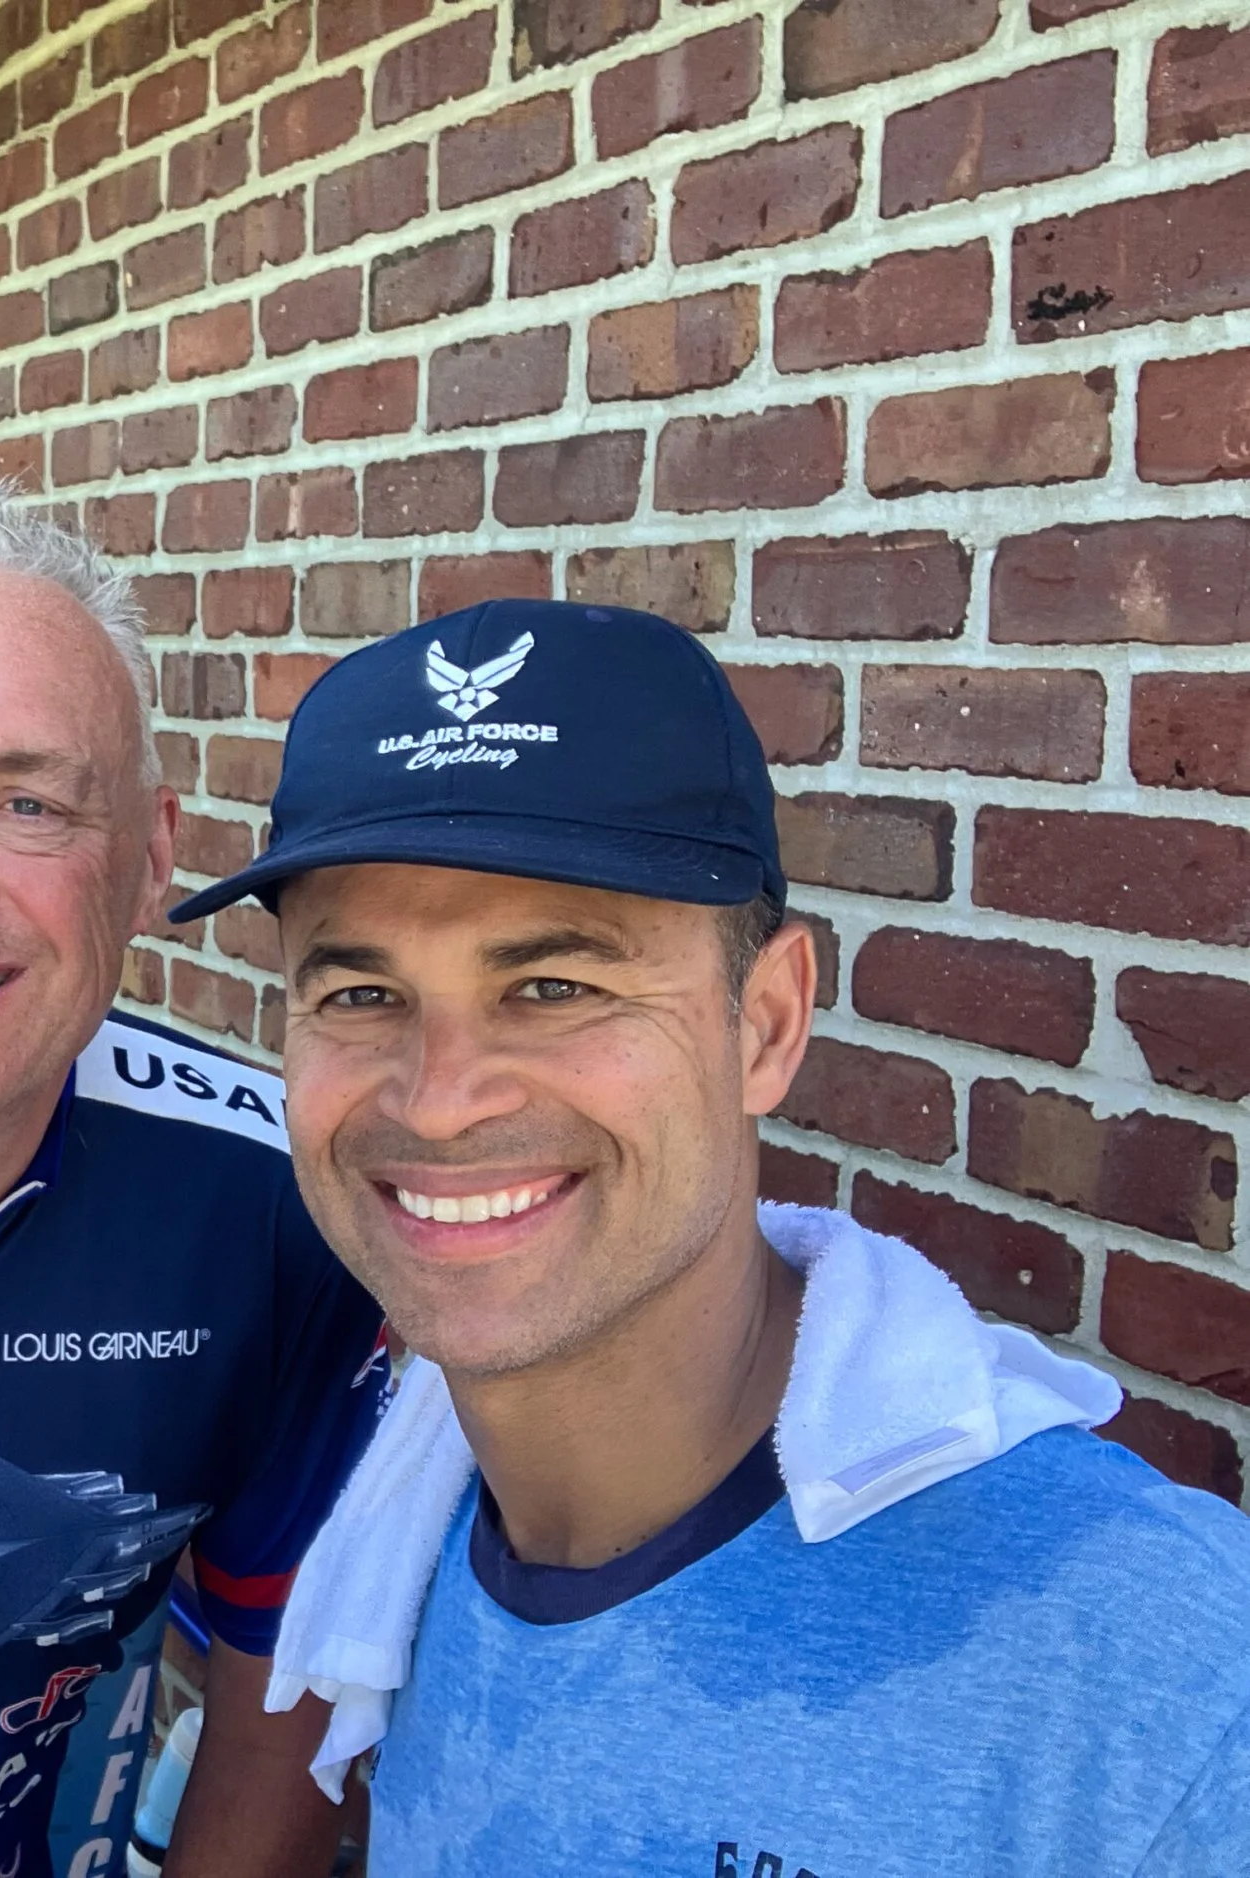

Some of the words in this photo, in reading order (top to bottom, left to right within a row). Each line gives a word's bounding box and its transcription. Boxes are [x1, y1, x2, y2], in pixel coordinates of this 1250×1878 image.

[420, 726, 462, 747] AIR
[466, 722, 559, 742] FORCE
[405, 741, 520, 771] Cycling
[112, 1046, 287, 1127] USA
[2, 1331, 82, 1362] LOUIS
